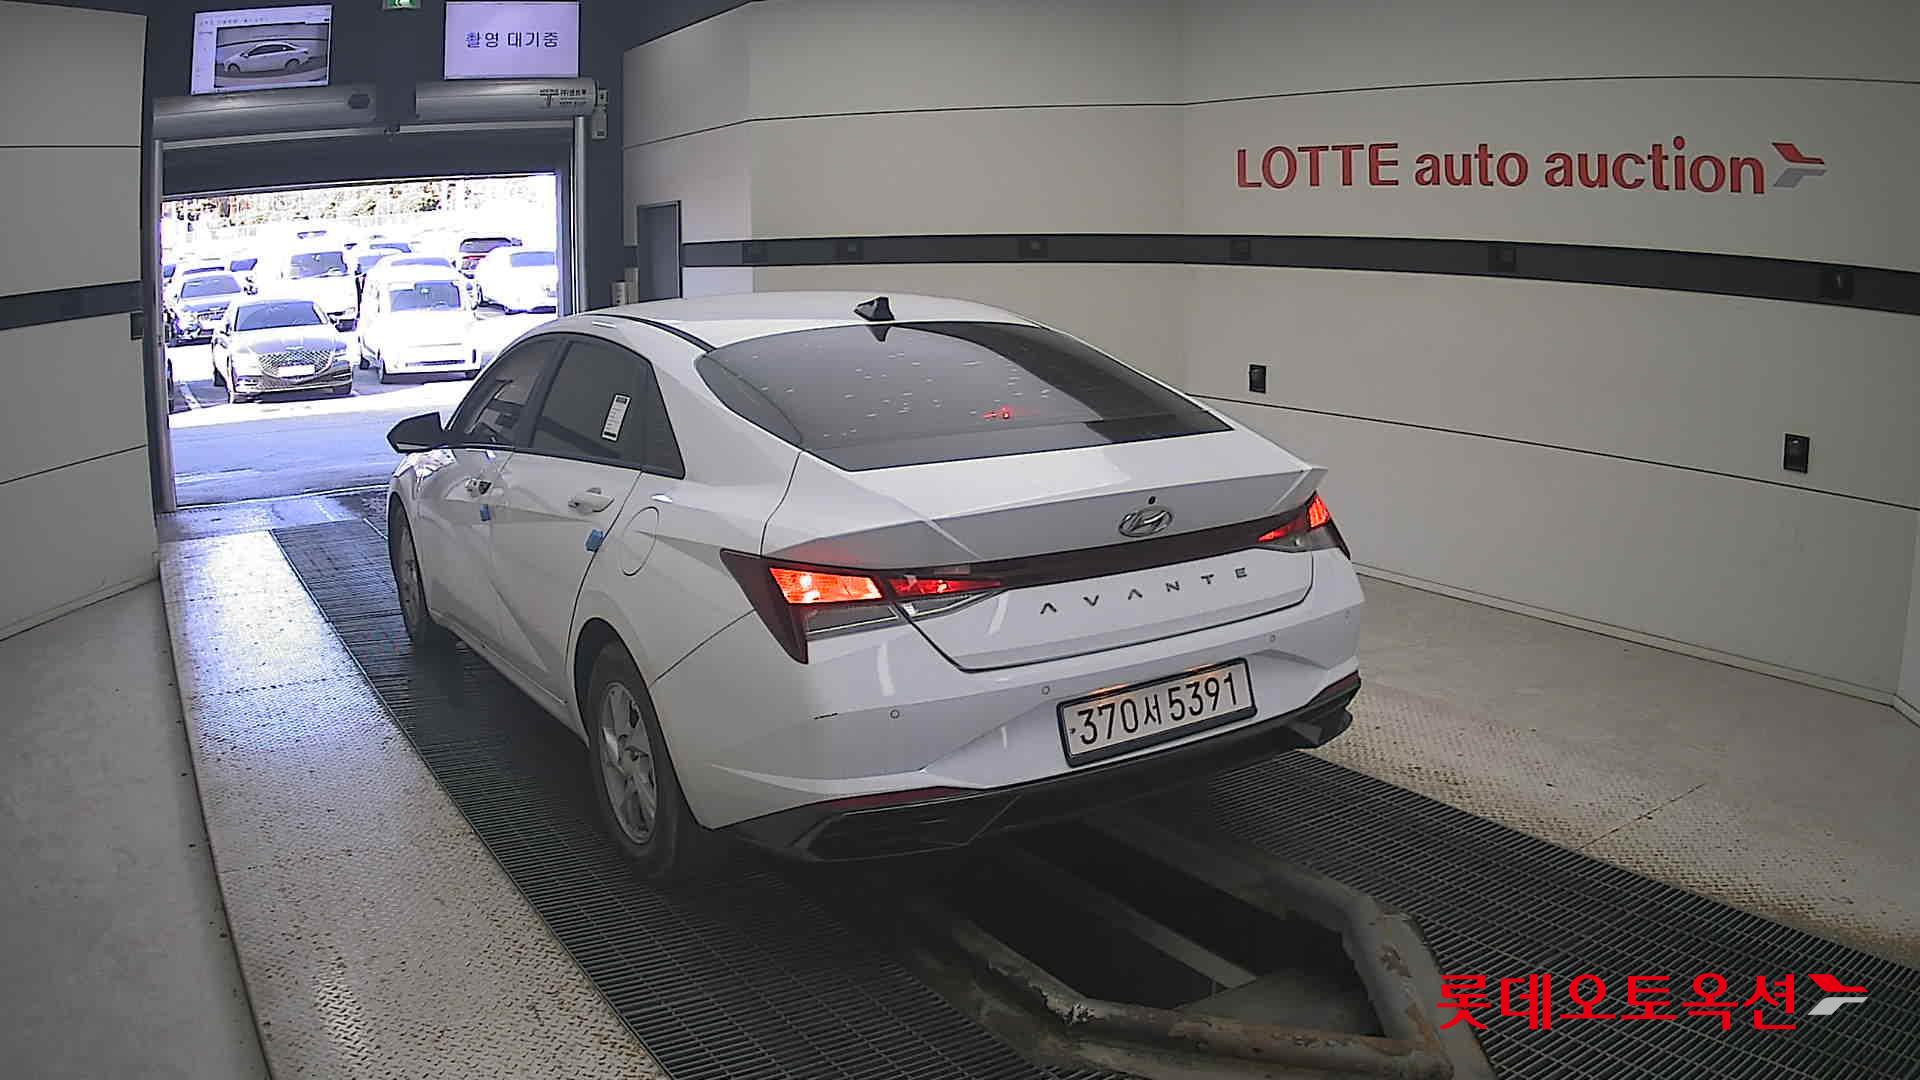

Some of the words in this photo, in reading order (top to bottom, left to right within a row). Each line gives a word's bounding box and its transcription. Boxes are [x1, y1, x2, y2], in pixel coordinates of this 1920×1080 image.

[507, 31, 561, 49] 대기중
[1237, 143, 1398, 188] LOTTE
[1415, 143, 1528, 187] auto
[1545, 136, 1765, 194] auction
[1040, 567, 1248, 616] AVANTE
